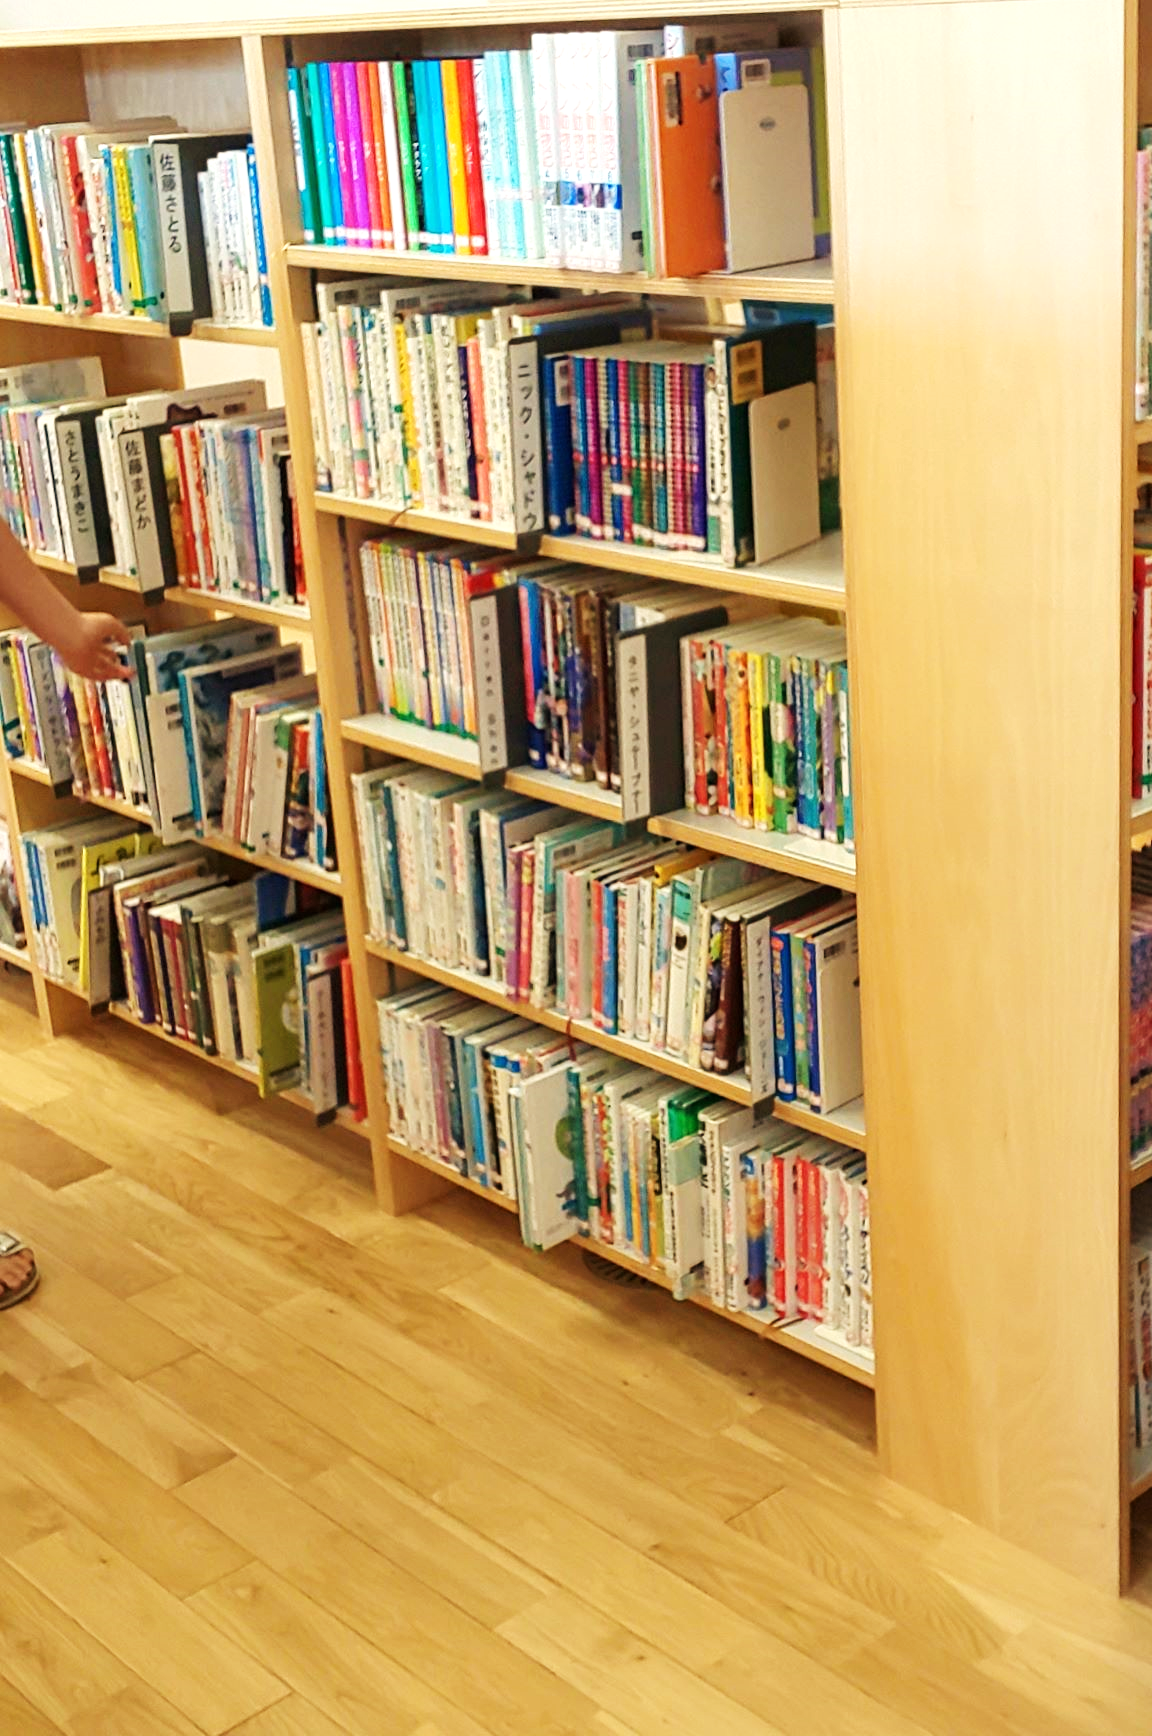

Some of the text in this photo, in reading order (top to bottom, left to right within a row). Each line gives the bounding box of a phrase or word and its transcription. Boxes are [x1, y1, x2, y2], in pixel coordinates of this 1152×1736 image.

[159, 152, 183, 254] 佐藤さとる
[65, 429, 88, 534] さとうまきこ
[124, 439, 152, 531] 佐藤まどか
[517, 363, 538, 531] ニック・シャドウ
